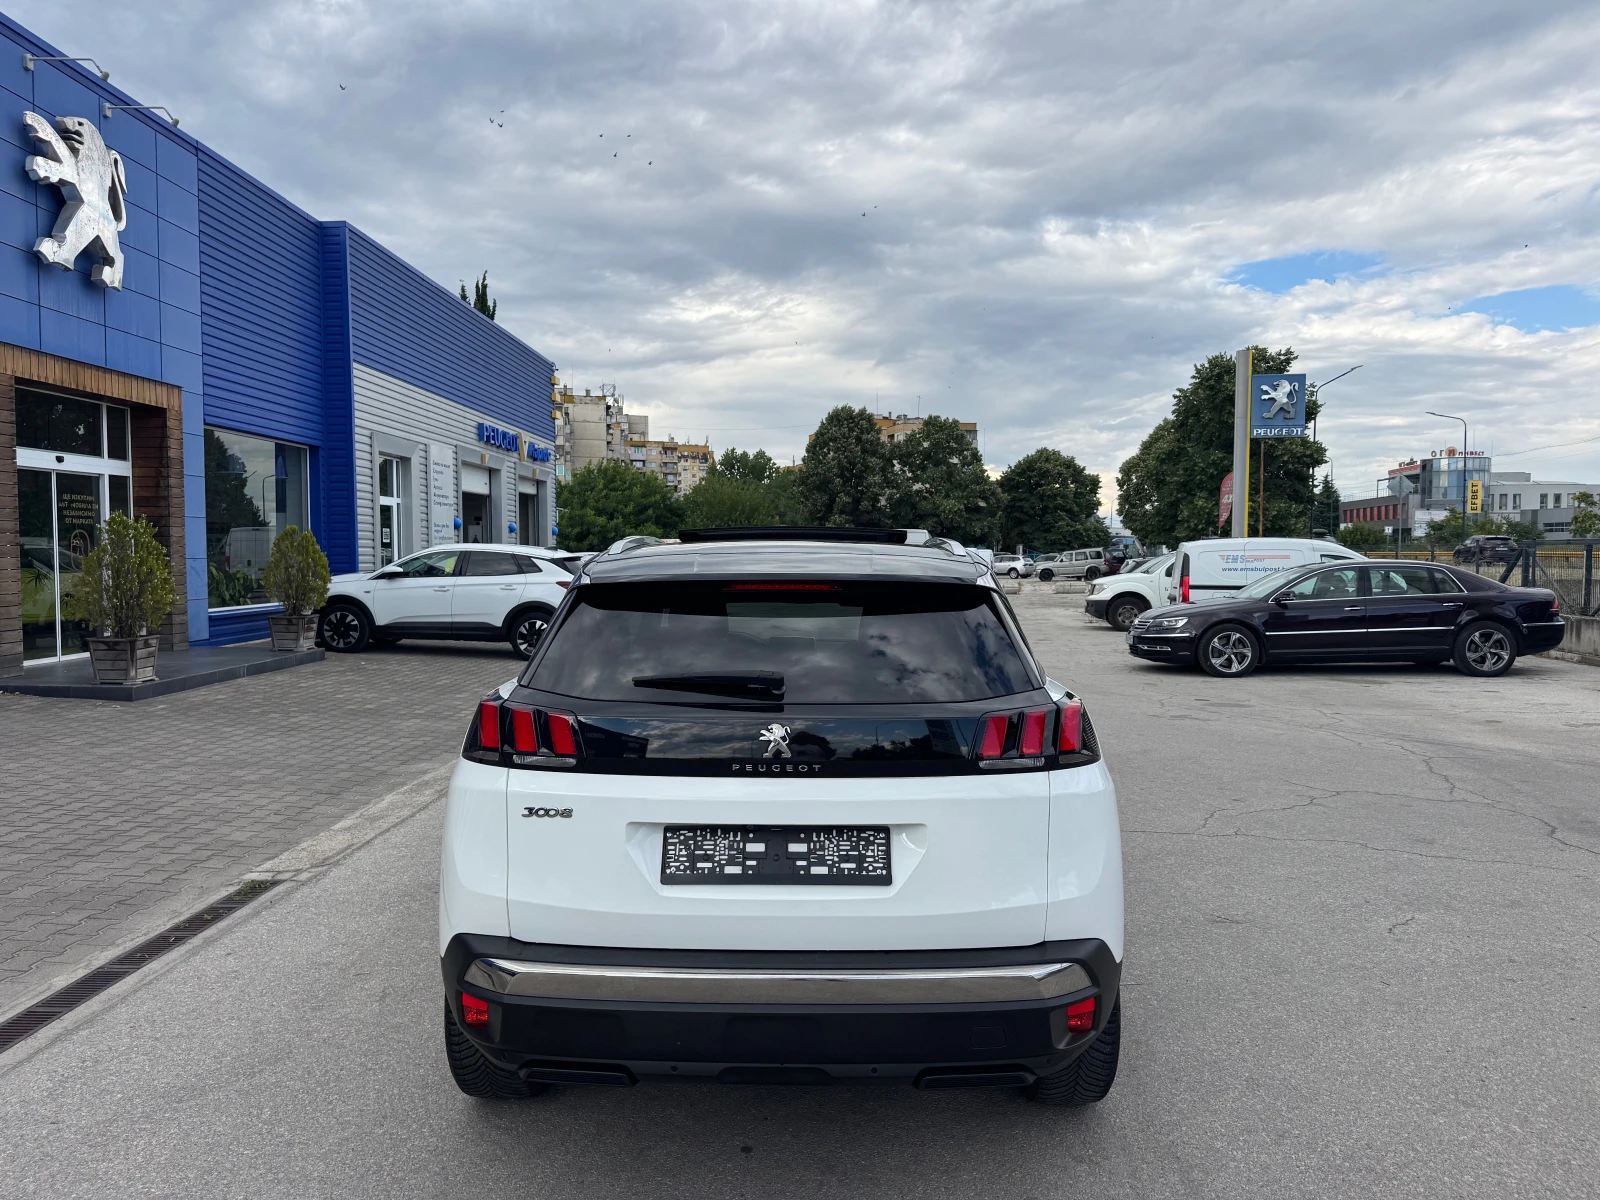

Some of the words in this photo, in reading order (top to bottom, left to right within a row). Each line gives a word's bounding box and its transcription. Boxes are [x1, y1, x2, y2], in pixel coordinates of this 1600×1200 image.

[1253, 428, 1303, 436] PEUGEOT
[478, 423, 519, 452] PEUGEOT
[62, 493, 71, 501] ЩЕ
[1470, 482, 1479, 511] EFBET
[1225, 555, 1245, 563] EMS
[732, 764, 821, 772] PEUGEOT
[521, 806, 573, 818] 3008
